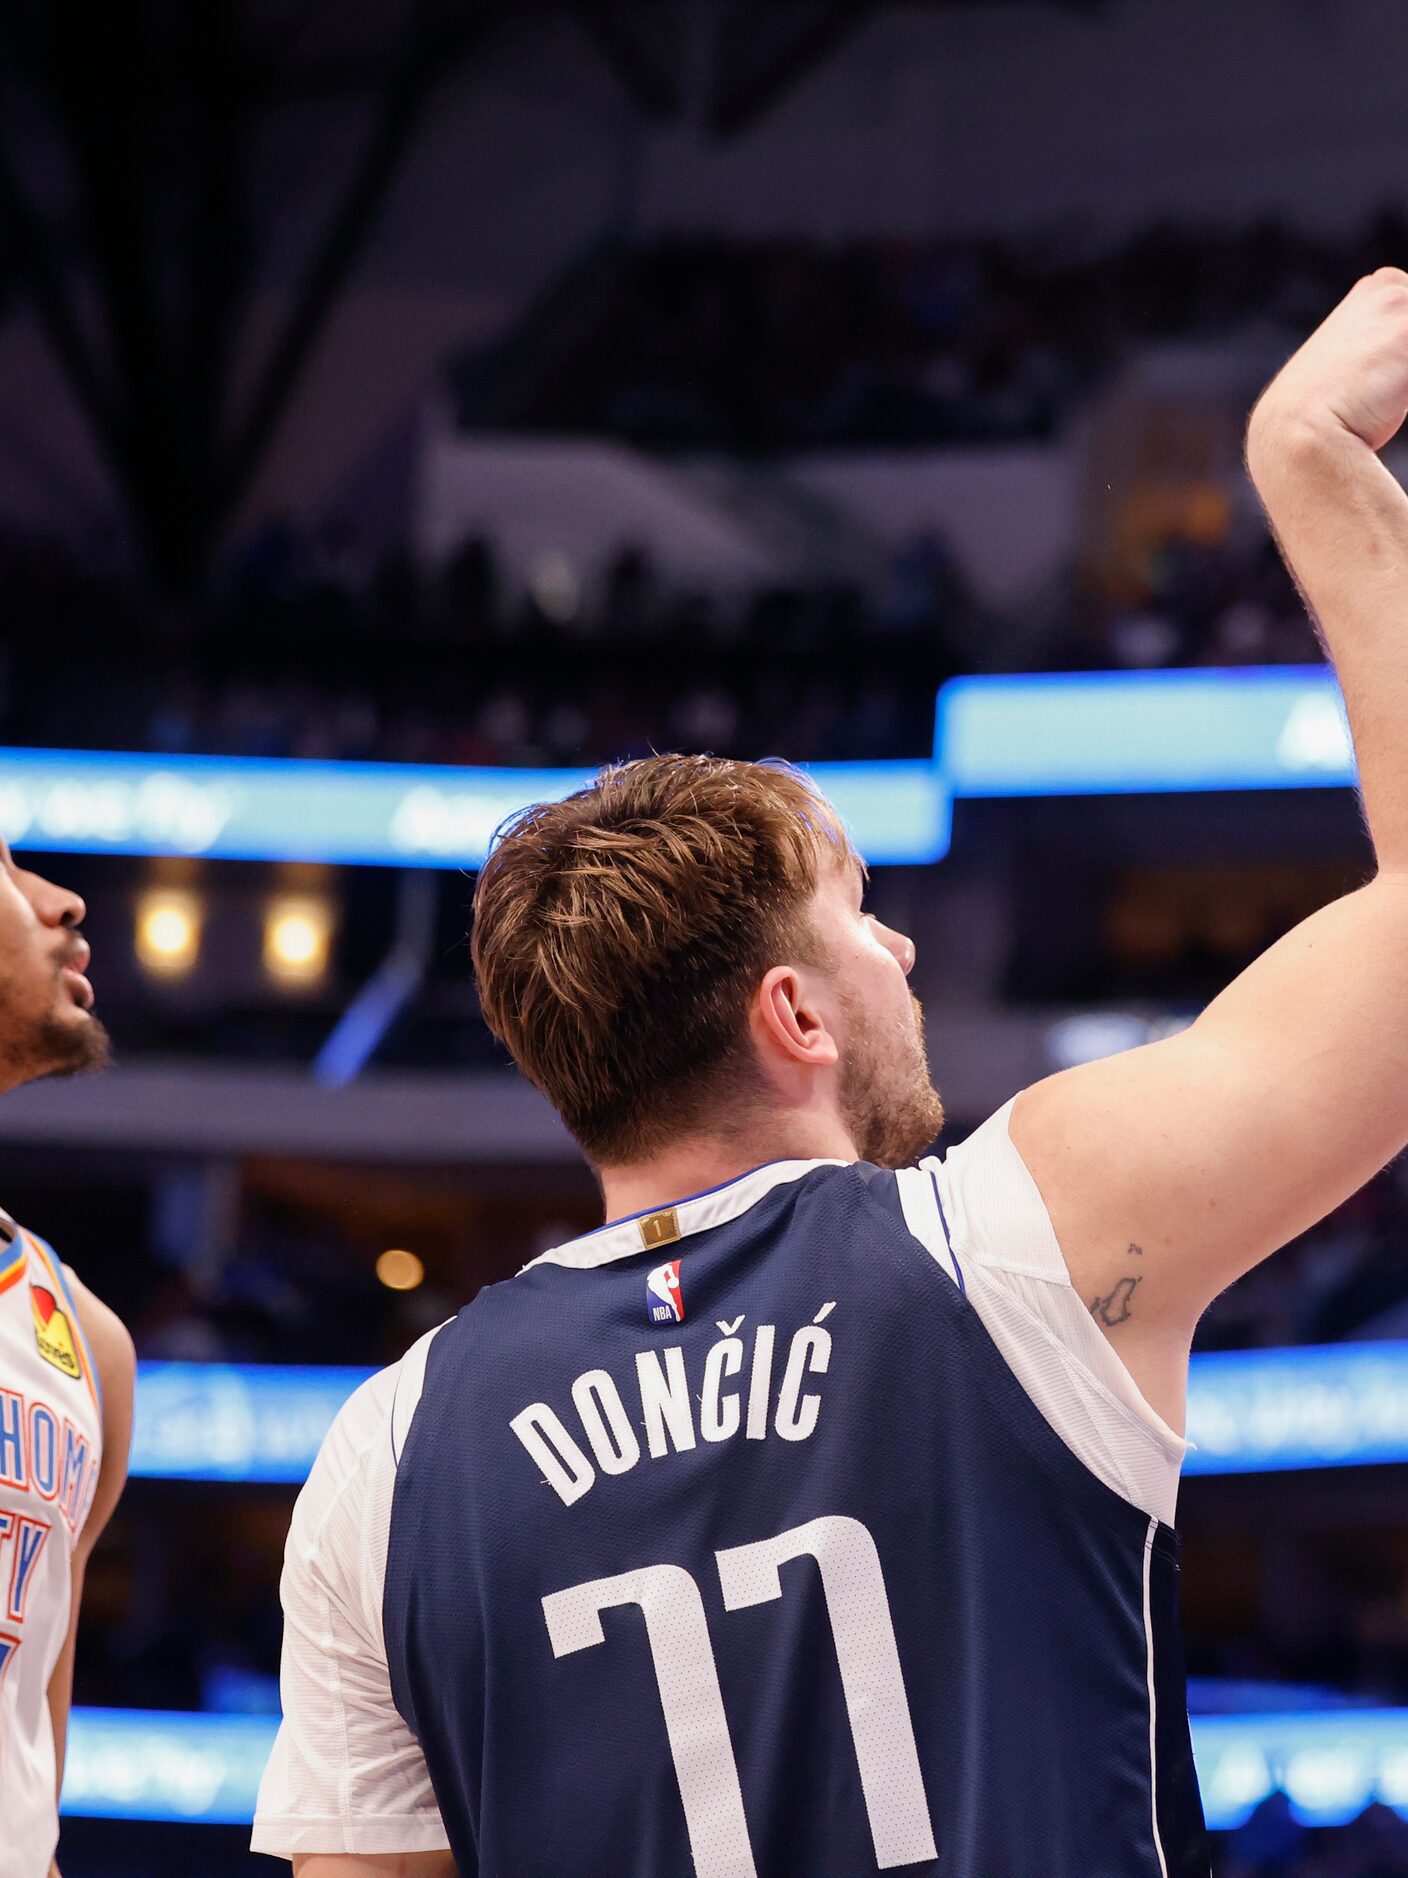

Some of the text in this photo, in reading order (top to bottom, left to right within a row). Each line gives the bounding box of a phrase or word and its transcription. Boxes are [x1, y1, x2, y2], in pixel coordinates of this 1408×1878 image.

[508, 1301, 837, 1507] DONČIĆ
[652, 1305, 672, 1321] NBA
[541, 1515, 939, 1878] 77
